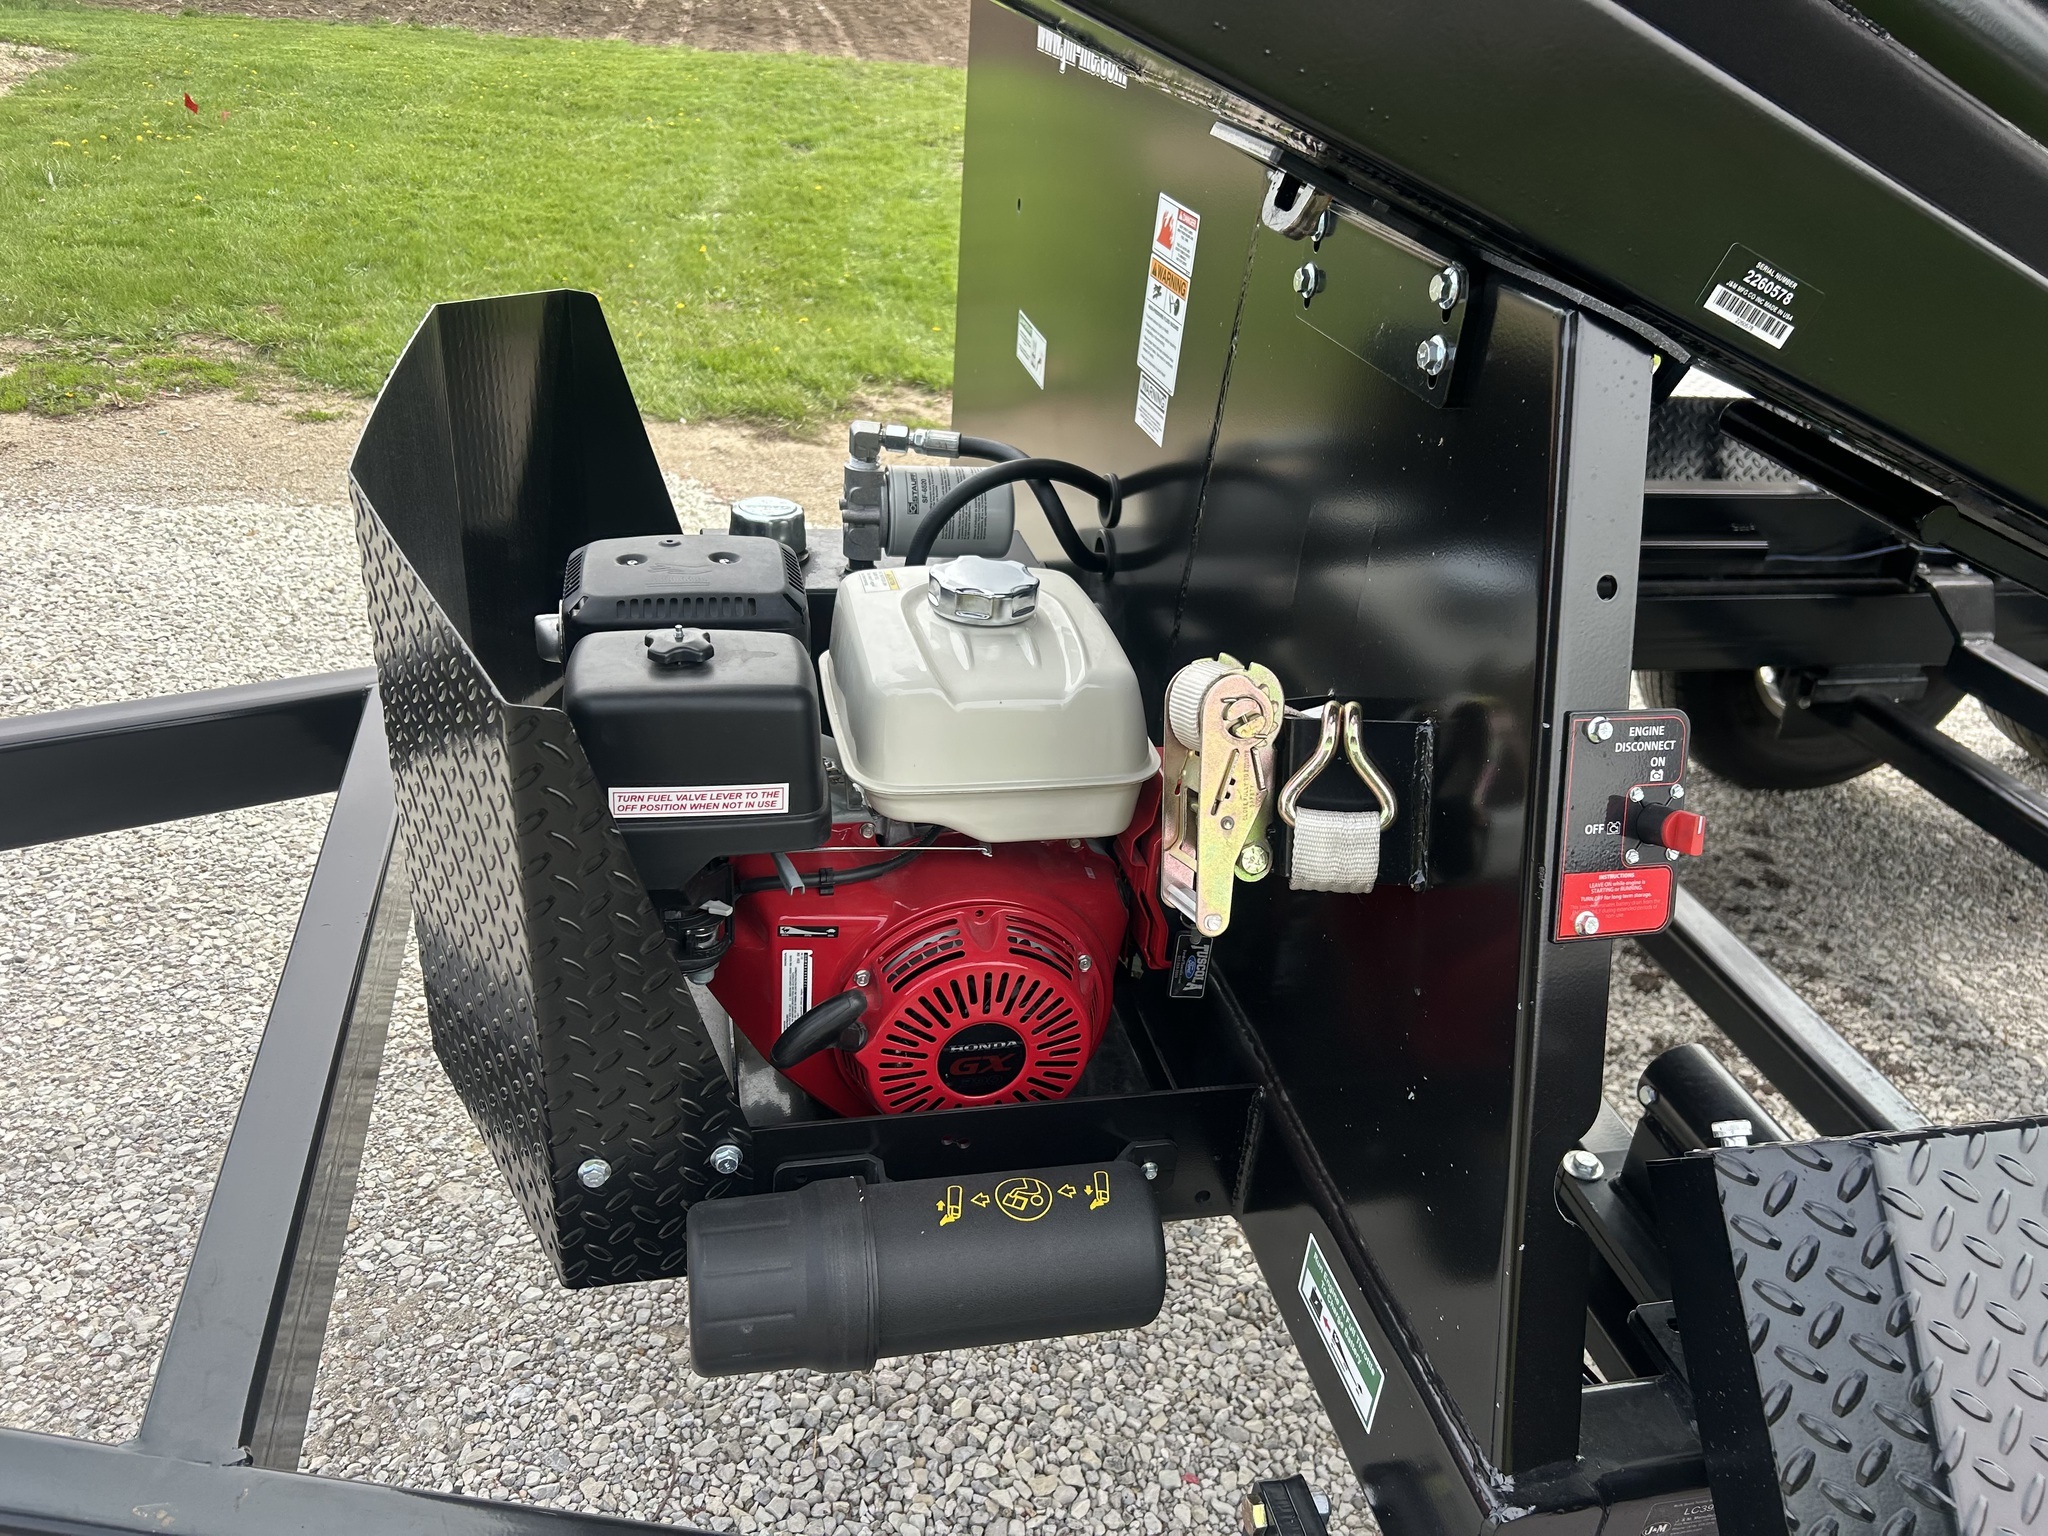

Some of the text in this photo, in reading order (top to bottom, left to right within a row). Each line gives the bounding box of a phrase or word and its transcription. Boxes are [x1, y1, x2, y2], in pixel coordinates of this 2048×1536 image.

[1158, 265, 1186, 296] WARNING
[1756, 262, 1798, 289] SERIAL NUMBER
[1742, 270, 1794, 306] 2260578
[1726, 280, 1794, 321] J&M MFG CO INC MADE IN USA
[1629, 726, 1665, 737] ENGINE
[1615, 740, 1676, 752] DISCONNECT
[1650, 757, 1666, 767] ON
[618, 795, 644, 803] TURN
[647, 794, 673, 802] FUEL
[676, 793, 707, 801] VALVE
[710, 792, 742, 801] LEVER
[617, 804, 637, 812] OFF
[640, 803, 686, 811] POSITION
[689, 802, 719, 810] WHEN
[722, 802, 743, 810] NOT
[757, 800, 777, 808] USE
[1585, 824, 1604, 834] OFF
[1598, 872, 1635, 880] INSTRUCTIONS
[1183, 944, 1209, 990] TUSCOLA
[950, 1041, 1018, 1052] HONDA
[950, 1053, 1016, 1075] GX
[1323, 1270, 1340, 1306] Engine
[1356, 1336, 1376, 1376] Throttle
[1326, 1293, 1344, 1330] Charge
[1344, 1328, 1362, 1365] Battery
[1645, 1523, 1668, 1535] J&M
